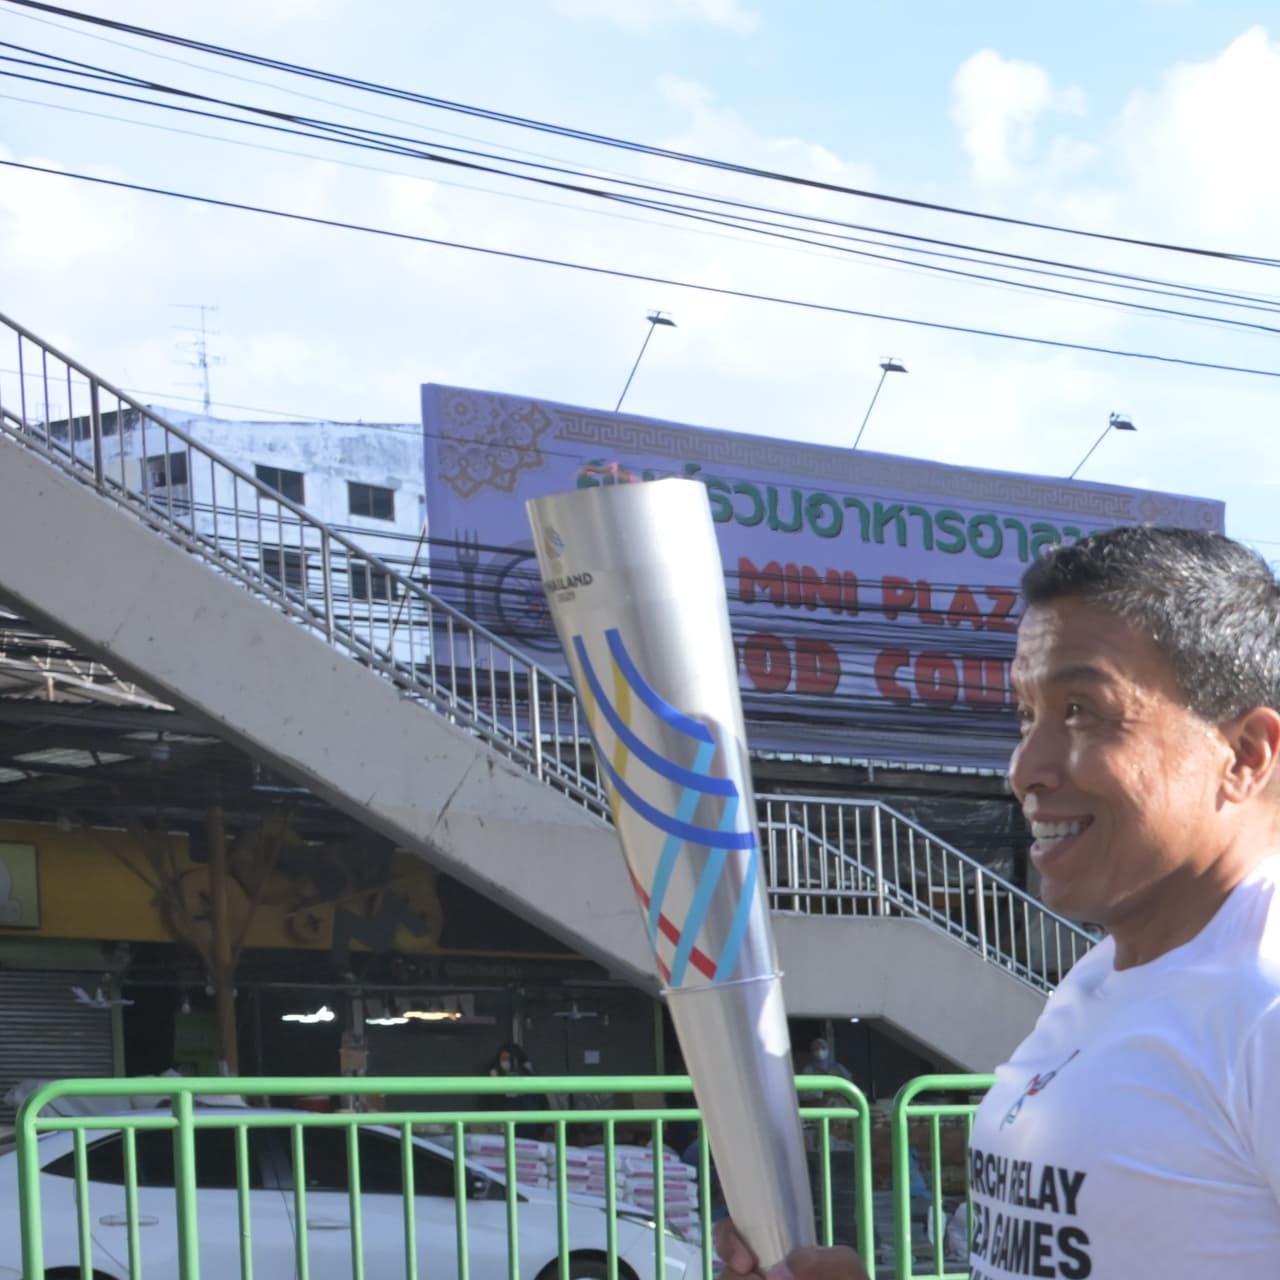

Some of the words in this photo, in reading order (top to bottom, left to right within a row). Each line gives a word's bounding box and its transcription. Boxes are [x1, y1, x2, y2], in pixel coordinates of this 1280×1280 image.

[738, 557, 859, 617] MINI
[883, 575, 1018, 634] PLAZ
[735, 631, 841, 695] OD
[873, 646, 1018, 709] COU
[1009, 1159, 1086, 1216] RELAY
[990, 1212, 1093, 1280] GAMES
